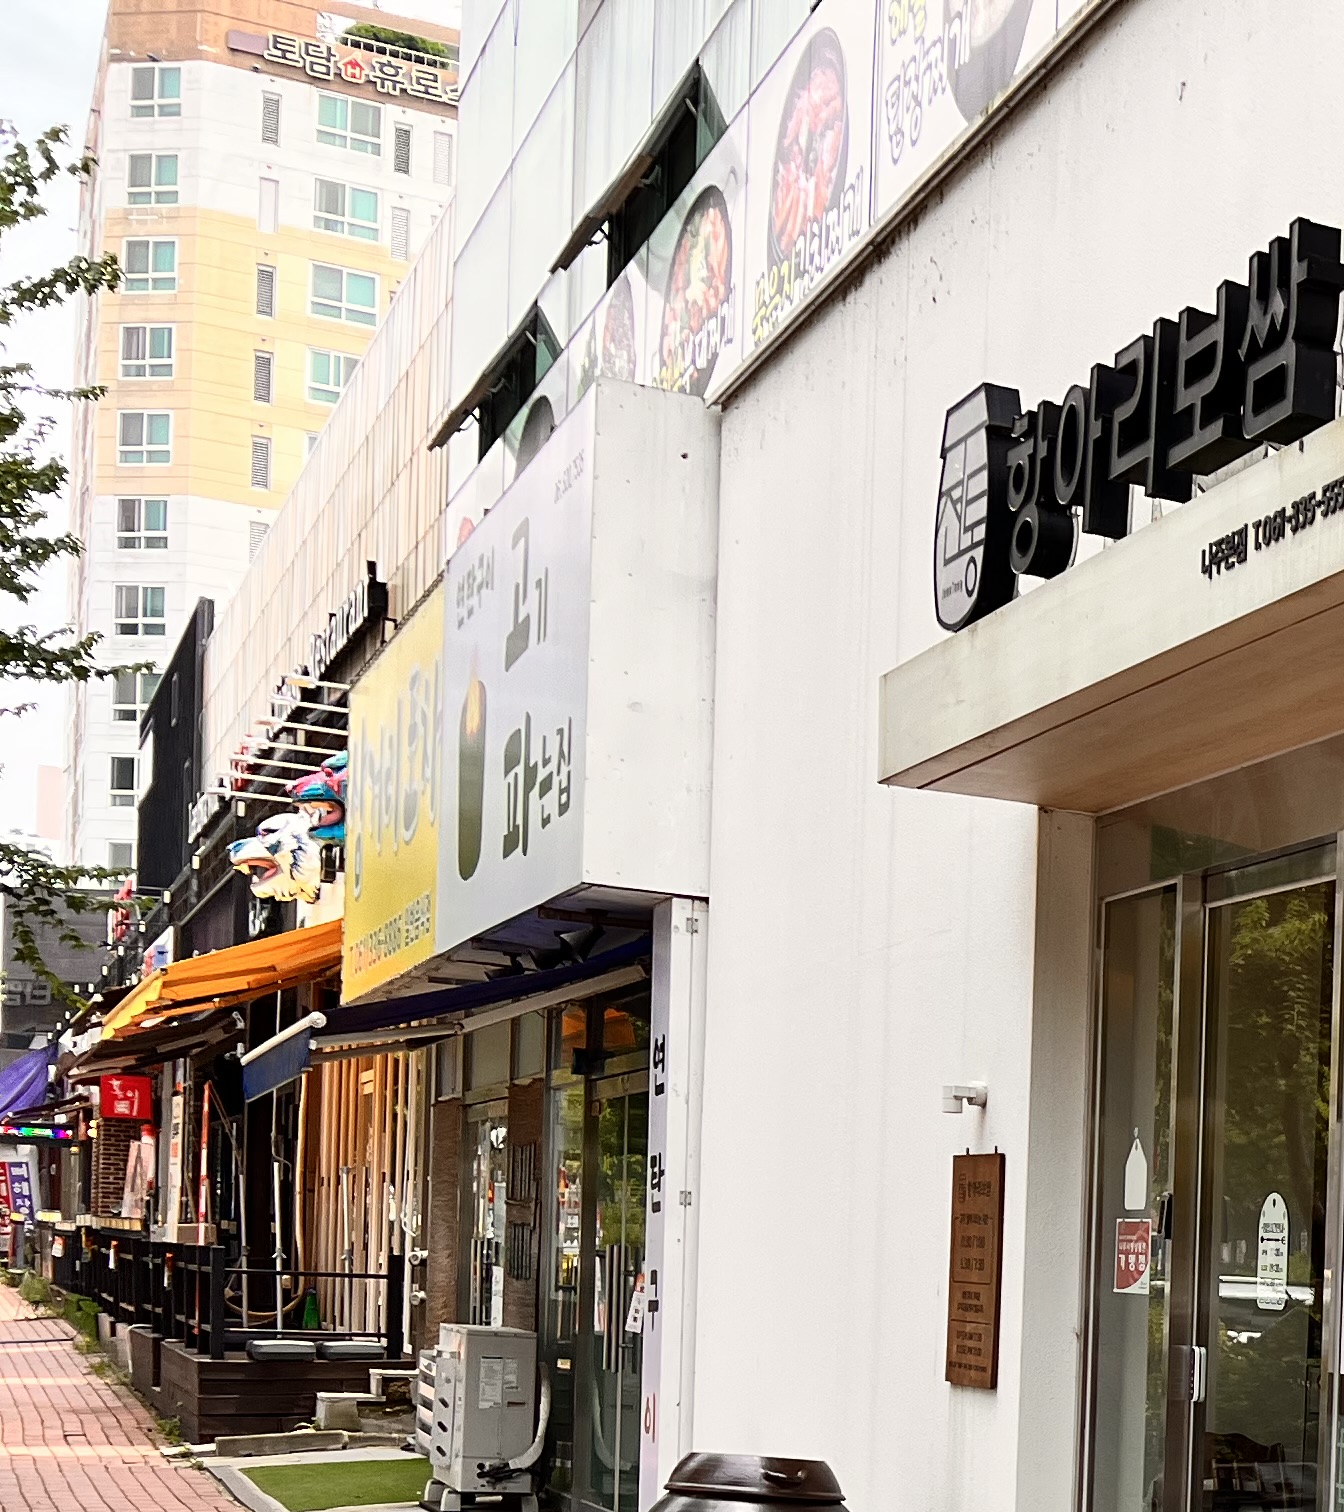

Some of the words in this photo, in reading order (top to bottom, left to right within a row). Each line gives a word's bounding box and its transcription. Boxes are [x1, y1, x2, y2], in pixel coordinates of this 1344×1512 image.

[264, 32, 339, 80] 토담
[504, 516, 549, 672] 고기
[502, 712, 573, 858] 파는집
[645, 1033, 666, 1443] 연탄구이
[1118, 1254, 1147, 1272] 가맹점
